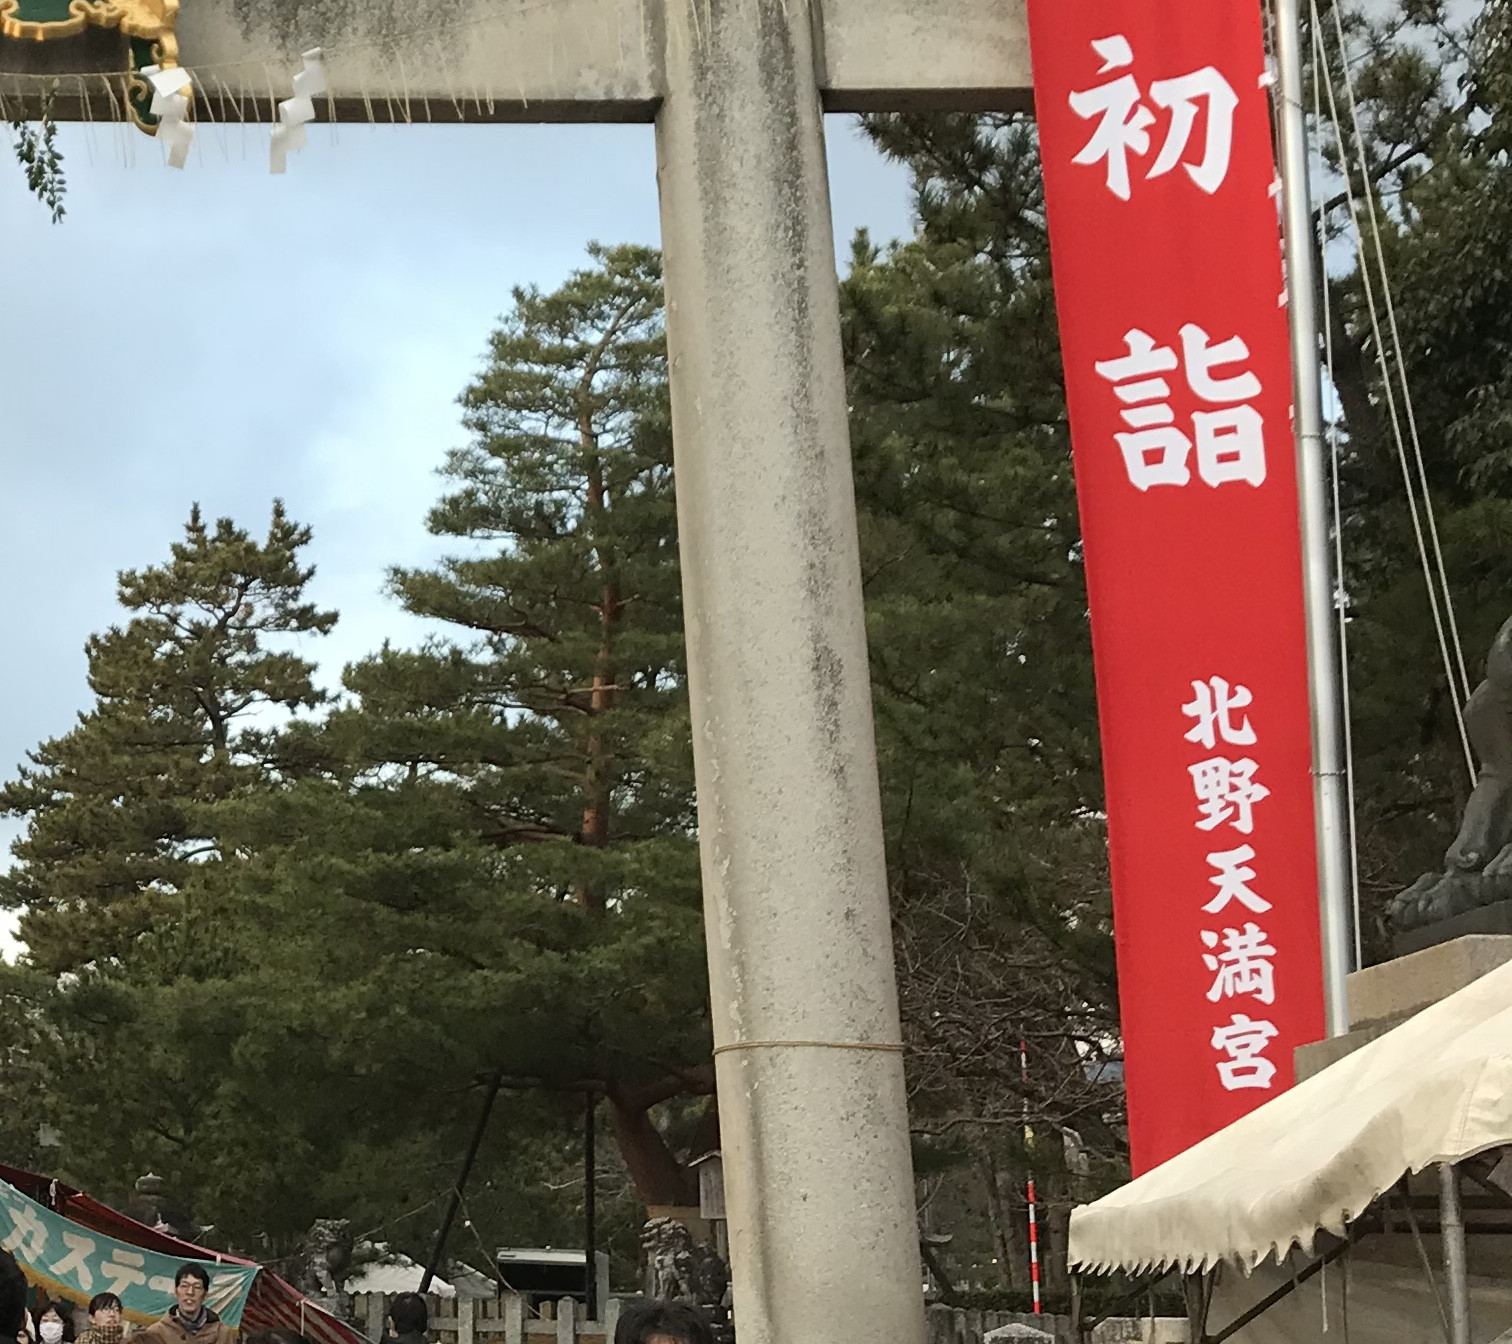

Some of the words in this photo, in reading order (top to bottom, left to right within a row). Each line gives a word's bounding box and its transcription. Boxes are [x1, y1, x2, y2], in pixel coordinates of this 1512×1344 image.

[1069, 34, 1267, 491] 初詣
[1183, 675, 1280, 1091] 北野天満宮
